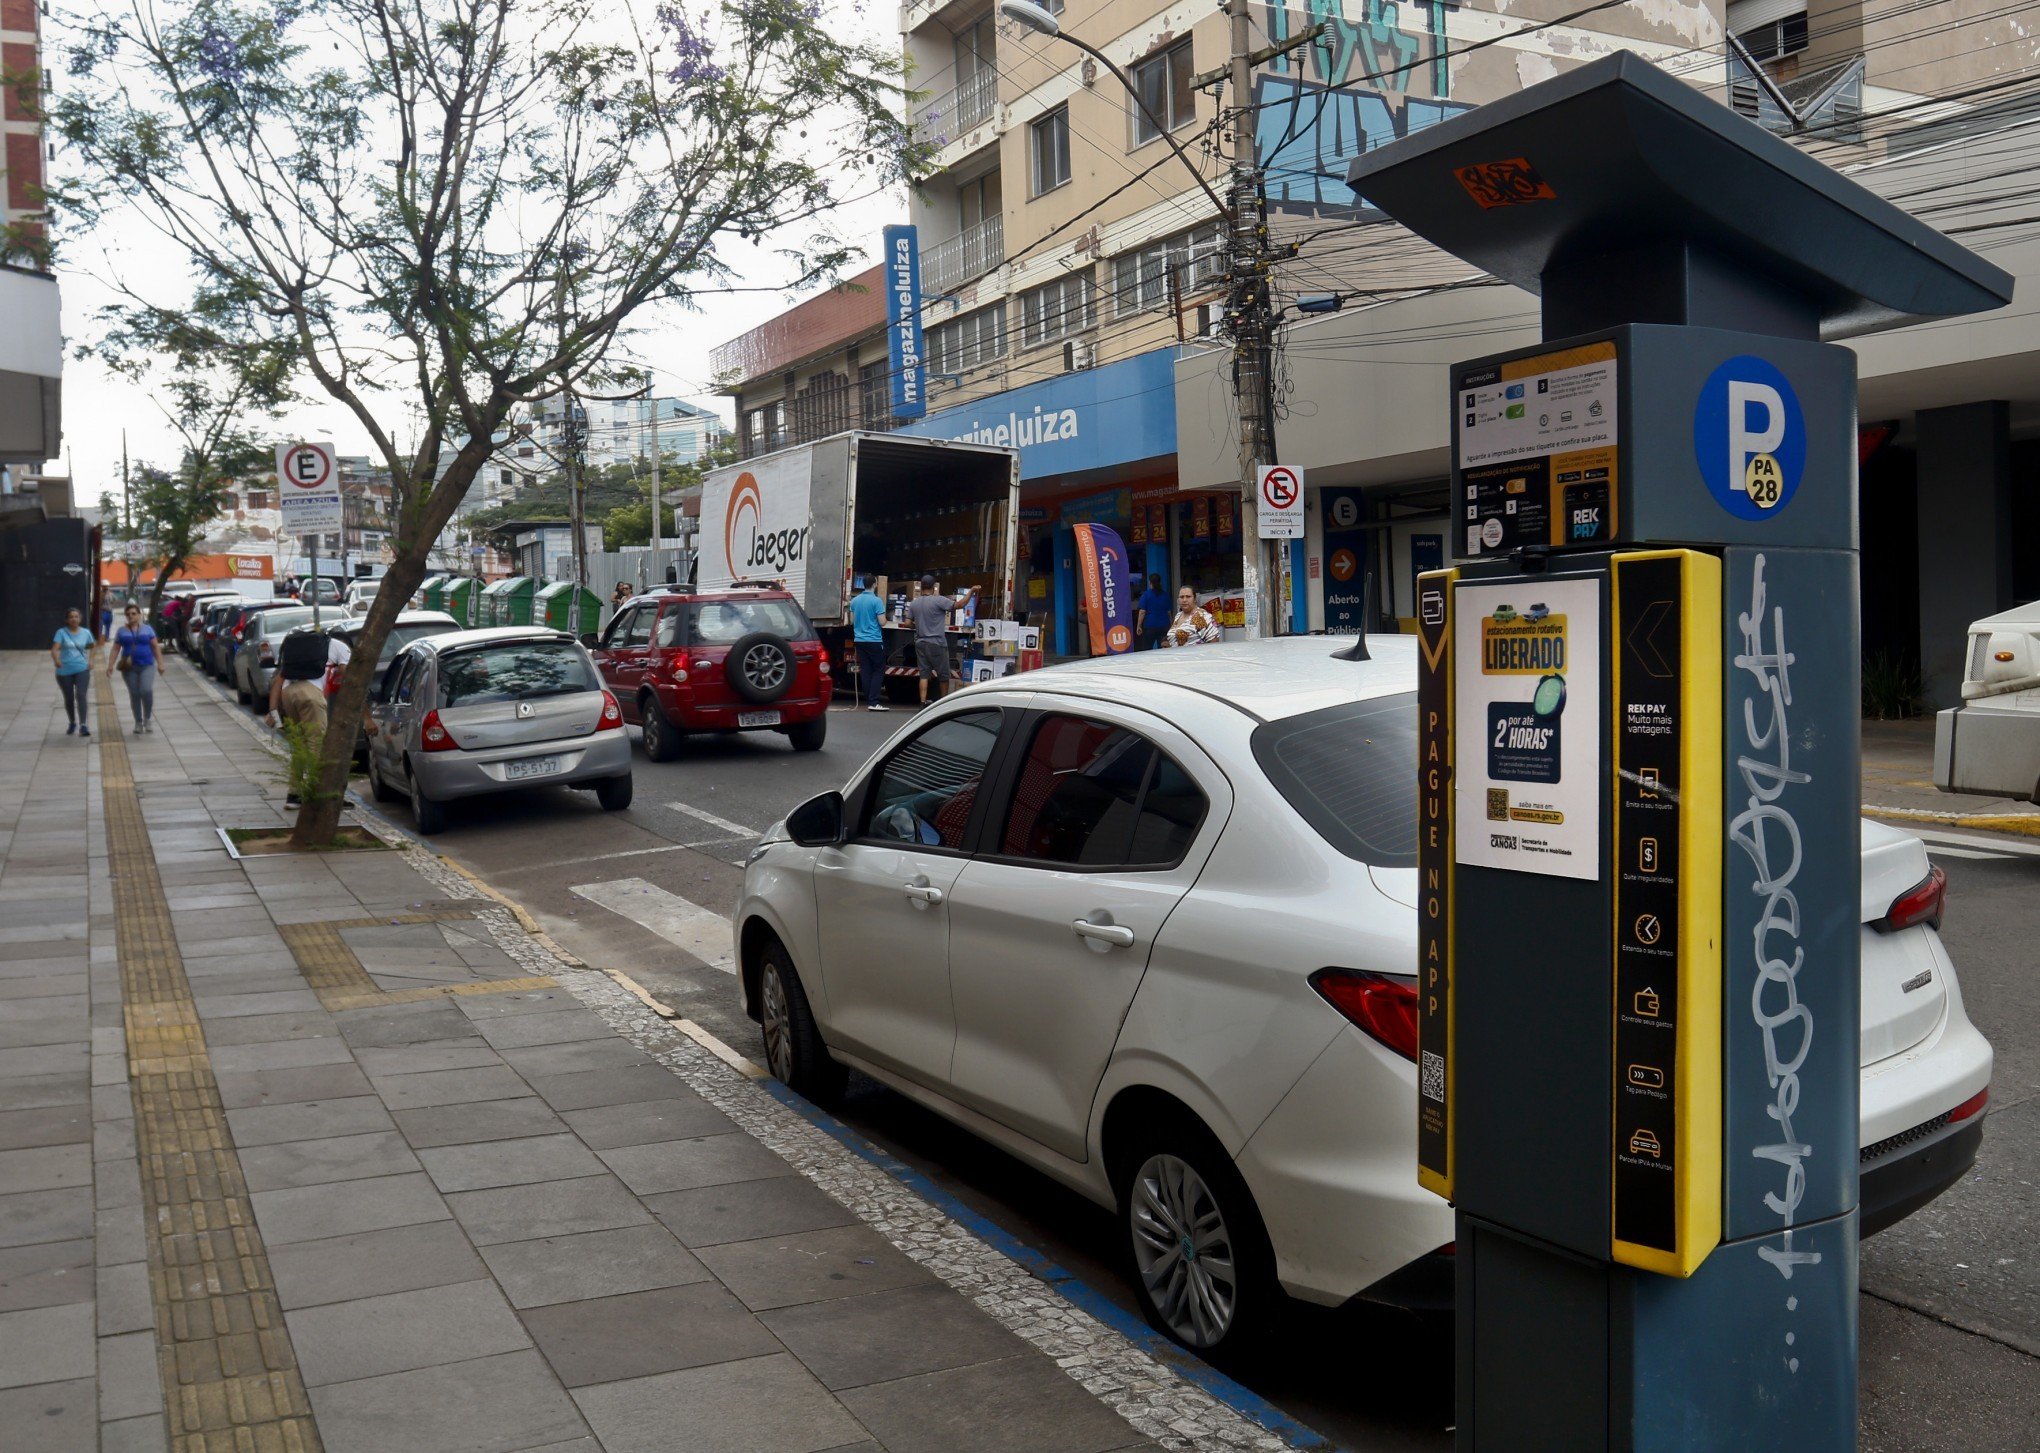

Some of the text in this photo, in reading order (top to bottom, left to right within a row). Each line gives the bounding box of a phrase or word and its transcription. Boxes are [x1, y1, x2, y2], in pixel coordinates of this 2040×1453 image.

[893, 238, 917, 404] magazineluiza
[952, 405, 1078, 448] ineluiza
[1728, 380, 1786, 491] P
[1467, 452, 1486, 462] Aguarde
[1492, 447, 1517, 458] impressão
[1561, 438, 1581, 447] confira
[1592, 433, 1608, 443] placa.
[297, 453, 317, 480] E
[1754, 459, 1774, 476] PA
[1752, 479, 1778, 502] 28
[1340, 504, 1351, 519] E
[1573, 507, 1599, 525] REK
[1196, 520, 1208, 532] 24
[1219, 518, 1232, 529] 24
[1573, 522, 1599, 539] PAY
[1134, 528, 1146, 540] 24
[1153, 526, 1166, 538] 24
[747, 525, 808, 572] Jaeger
[1328, 594, 1359, 605] Aberto
[1339, 612, 1350, 620] ao
[1487, 624, 1563, 636] estacionamento rotativo
[1112, 632, 1127, 645] E
[1485, 637, 1564, 670] LIBERADO
[1628, 704, 1666, 714] REK PAY
[1508, 715, 1535, 727] por até
[1628, 715, 1672, 725] Muito mais
[1494, 719, 1507, 748] 2
[1628, 725, 1673, 737] vantagens.
[508, 761, 557, 776] IPS 5137
[1513, 811, 1560, 821] canoas.rs.gov.br
[1490, 839, 1517, 850] CANOAS
[1522, 845, 1545, 853] Transportes
[1549, 848, 1572, 856] Mobilidade
[1428, 711, 1439, 1017] PAGUE NO APP
[1638, 875, 1674, 884] irregularidades
[1622, 944, 1642, 953] Estenda
[1657, 949, 1674, 957] tempo
[1622, 1014, 1673, 1028] Controle seus gastos
[1626, 1085, 1668, 1100] Tag para Pedágio
[1619, 1154, 1637, 1165] Parcele
[1638, 1159, 1650, 1167] IPVA
[1655, 1162, 1673, 1171] Multas
